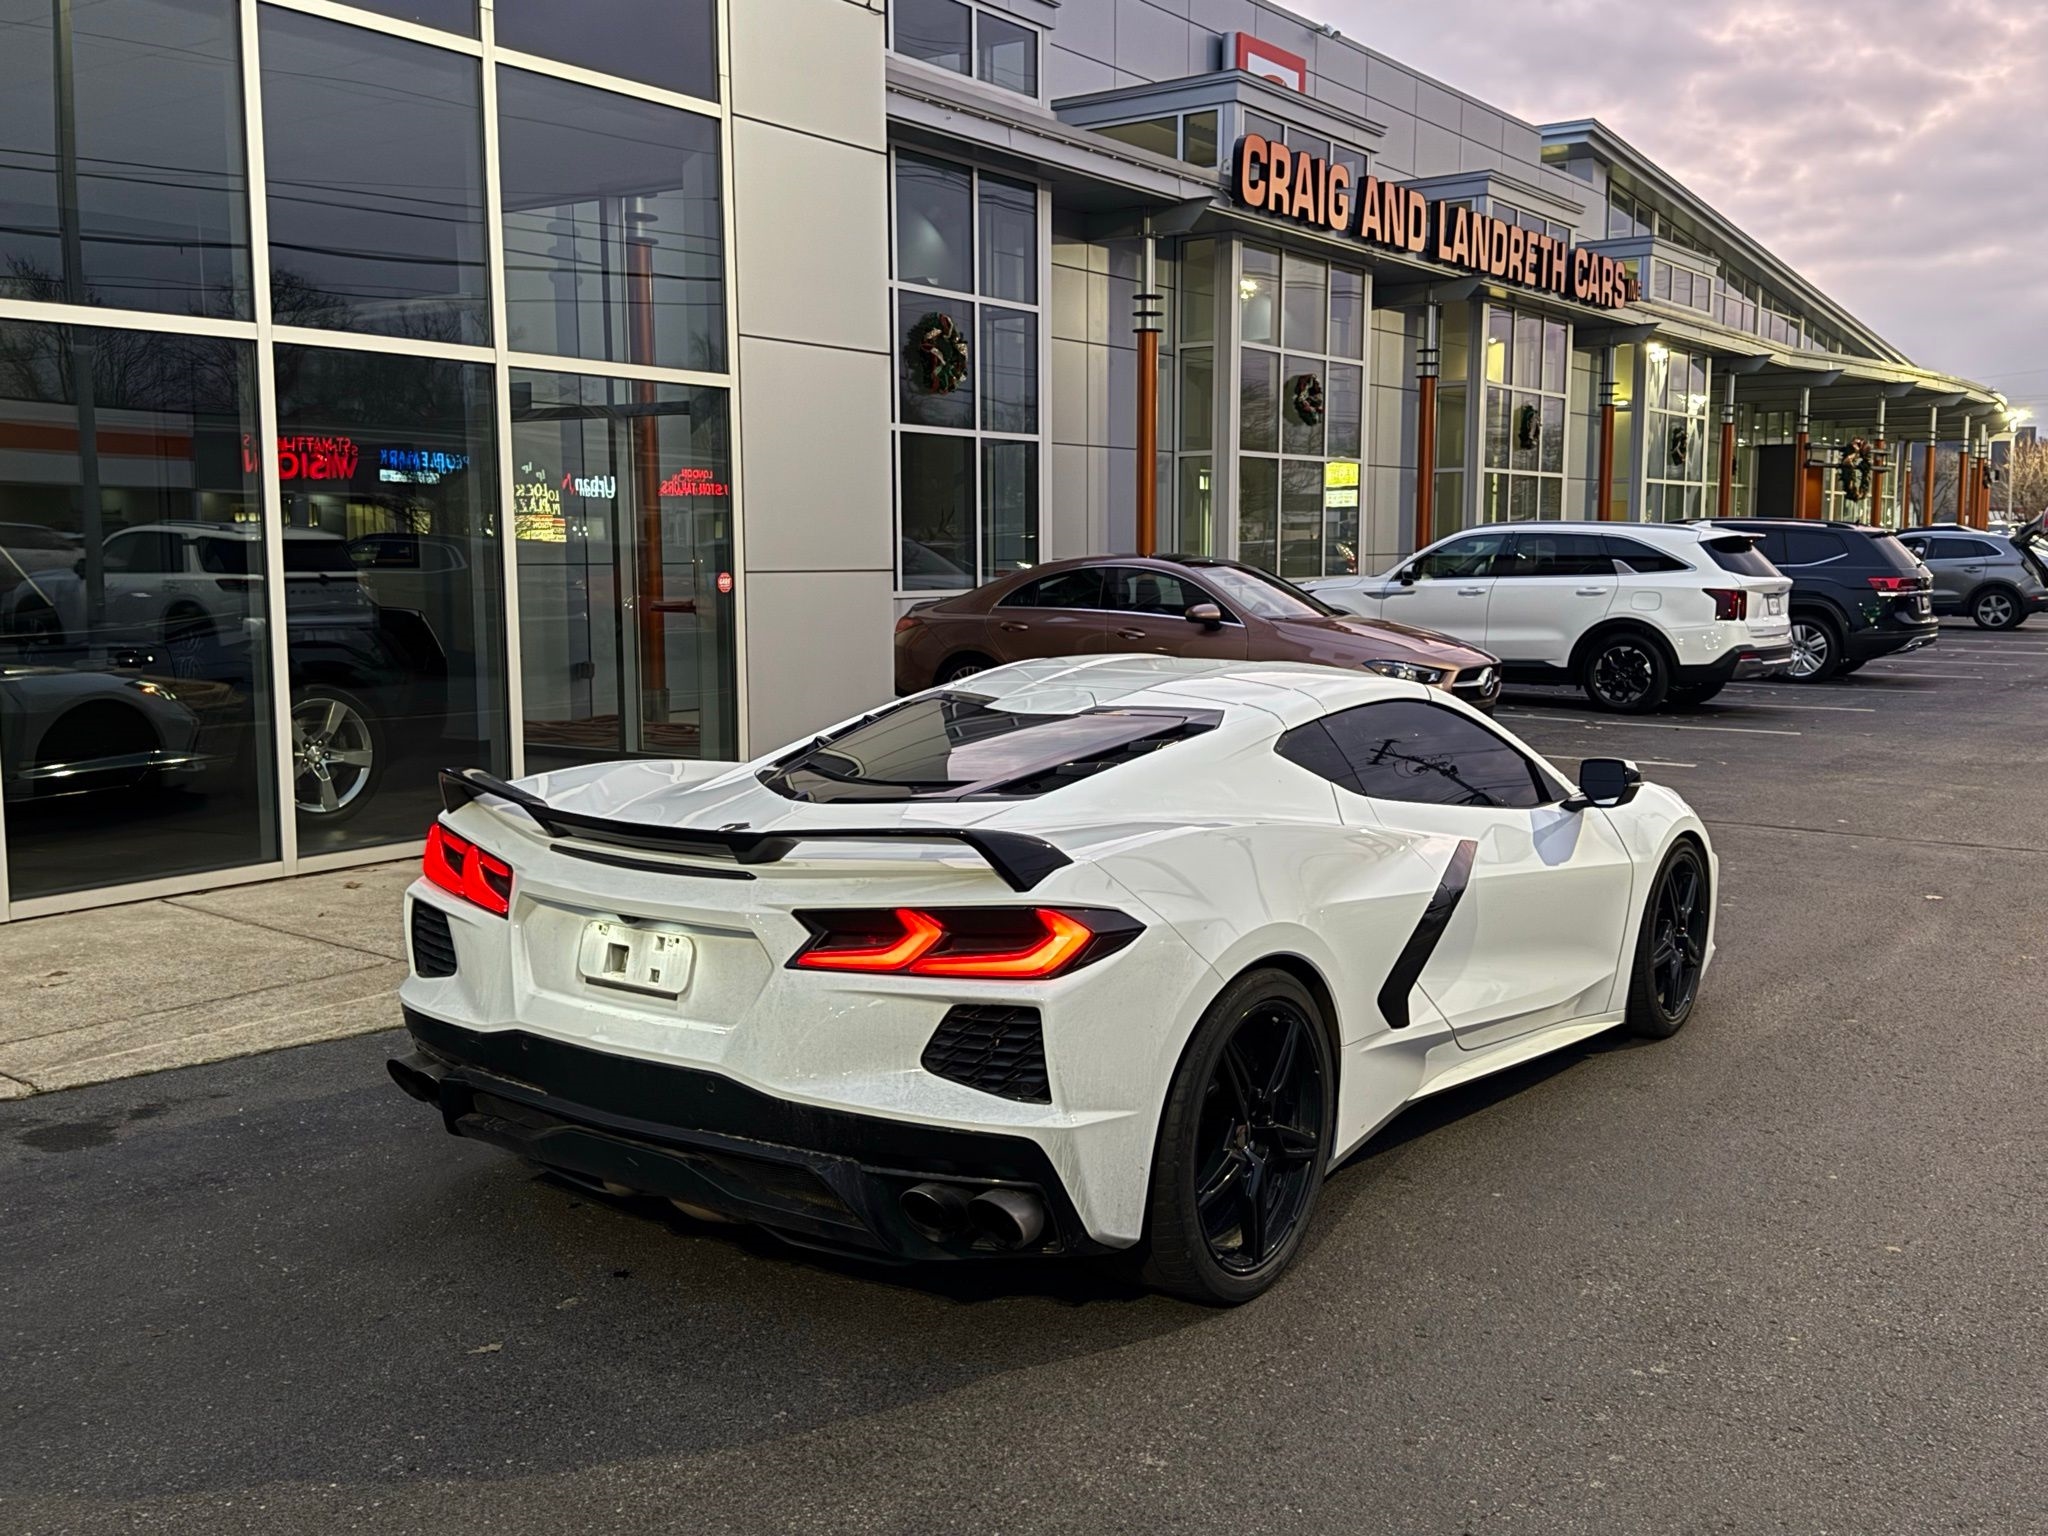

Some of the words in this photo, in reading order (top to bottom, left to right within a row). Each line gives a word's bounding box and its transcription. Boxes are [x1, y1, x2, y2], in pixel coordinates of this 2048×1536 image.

[1241, 133, 1350, 231] CRAIG
[1361, 176, 1427, 253] AND
[1438, 200, 1567, 294] LANDRETH
[1574, 247, 1626, 309] CARS
